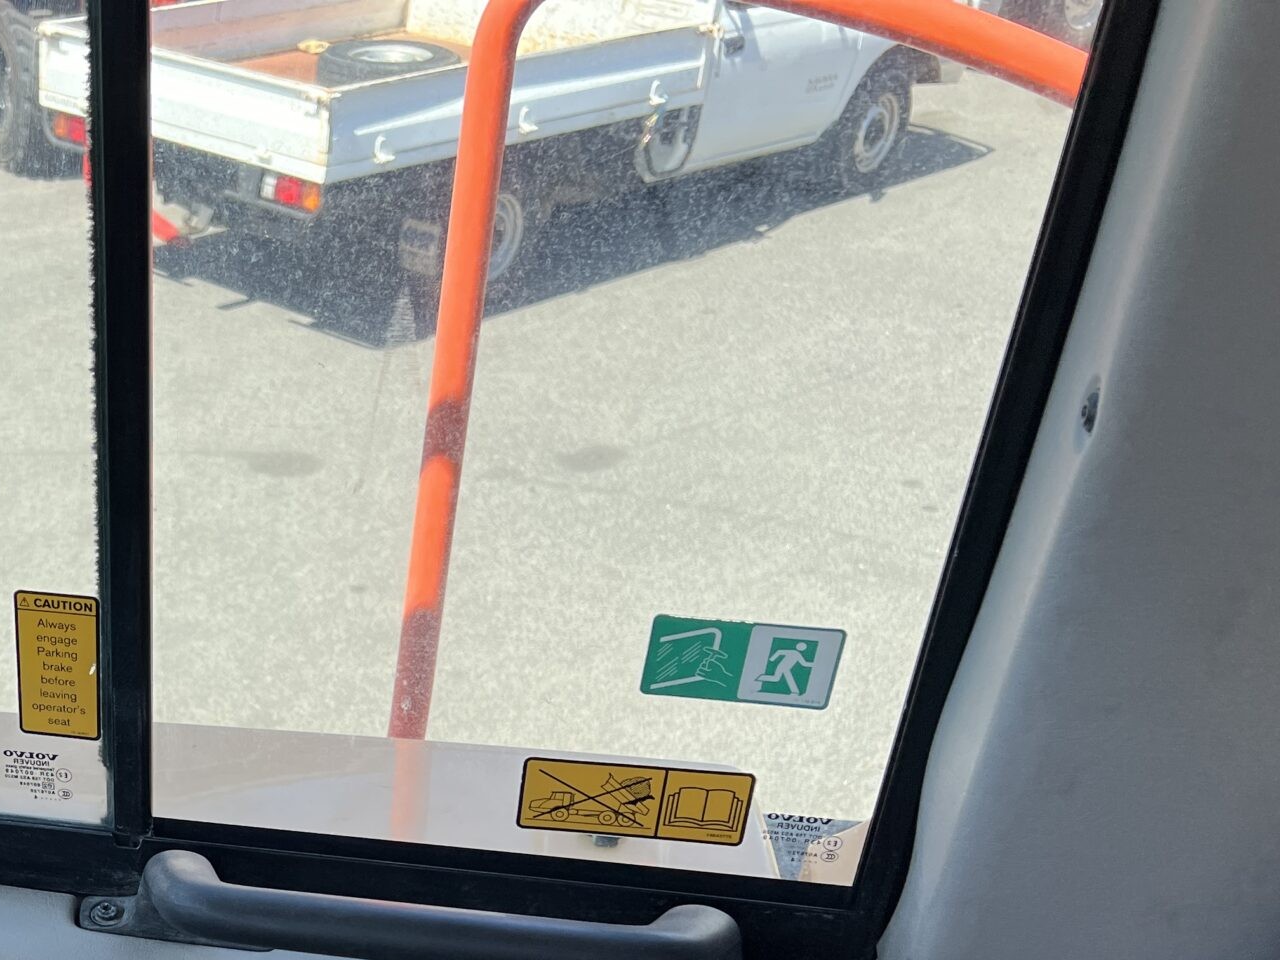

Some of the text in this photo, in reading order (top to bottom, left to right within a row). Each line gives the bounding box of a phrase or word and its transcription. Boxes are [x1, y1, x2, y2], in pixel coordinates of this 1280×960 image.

[33, 598, 93, 612] CAUTION
[37, 618, 77, 633] Always
[36, 634, 78, 647] engage
[37, 646, 78, 662] Parking
[42, 661, 73, 673] brake
[40, 675, 76, 687] before
[39, 688, 77, 703] leaving
[32, 703, 86, 715] operator's
[47, 717, 71, 727] seat
